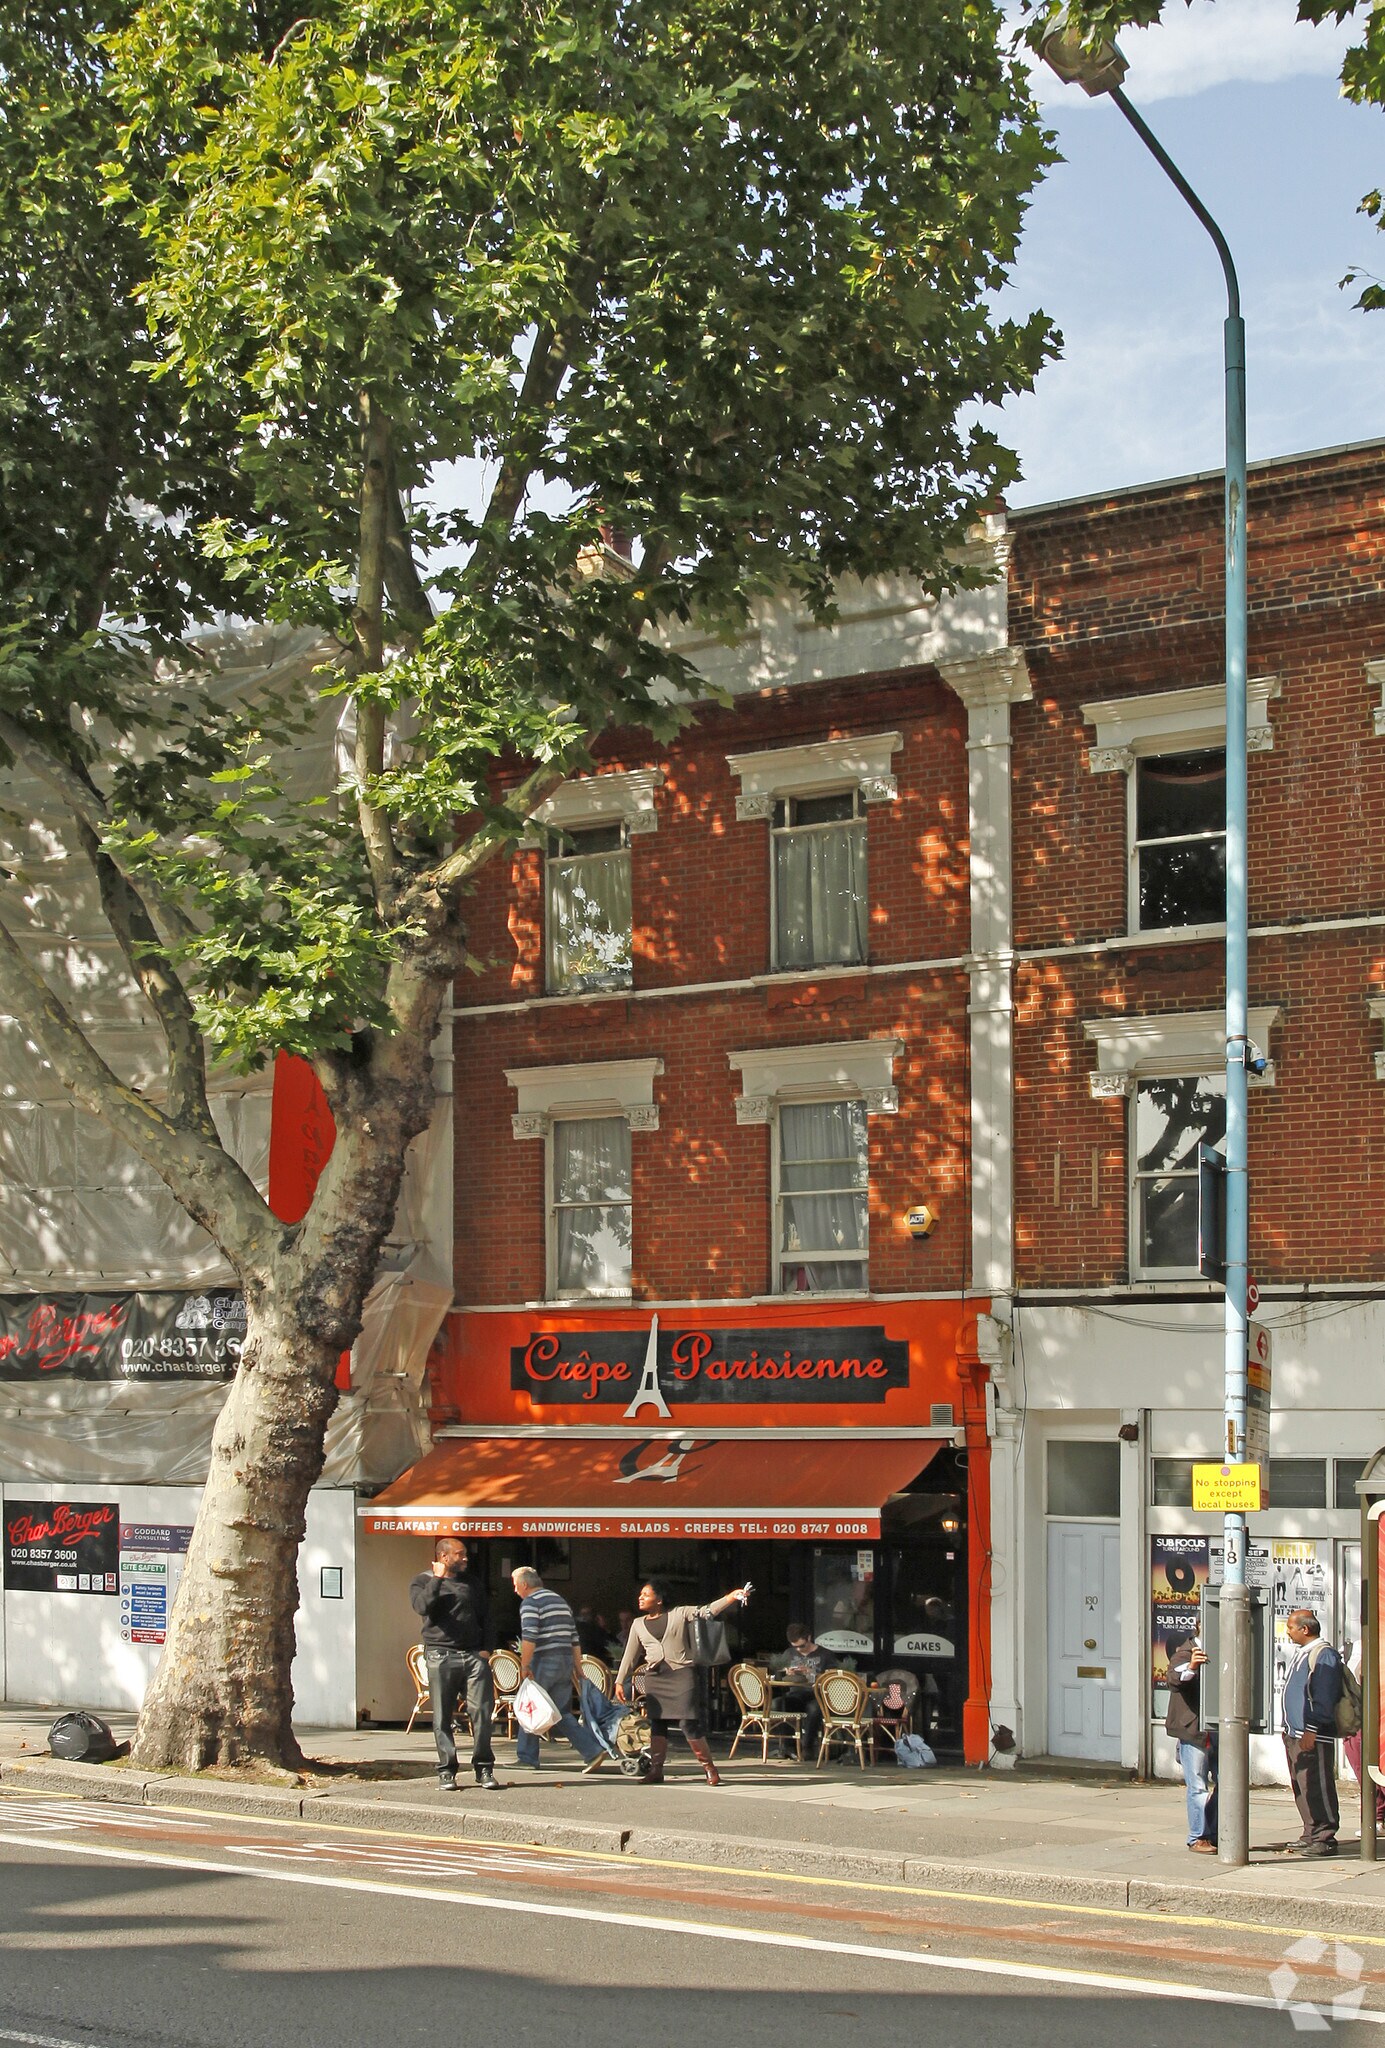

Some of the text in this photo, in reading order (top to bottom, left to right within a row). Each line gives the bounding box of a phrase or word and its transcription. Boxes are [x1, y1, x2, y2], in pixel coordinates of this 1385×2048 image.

[910, 1215, 924, 1223] ADT
[19, 1303, 127, 1370] Berger
[121, 1337, 243, 1358] 020 8357 36
[524, 1332, 889, 1400] Crêpe Parisienne
[1195, 1479, 1256, 1488] No stopping
[1209, 1490, 1242, 1498] except
[8, 1504, 115, 1546] Chas Berger
[373, 1521, 868, 1534] BREAKFAST COFFEES SANDWICHES SALADS CREPES TEL: 020 8747 0008
[134, 1528, 171, 1536] GODDARD
[1156, 1538, 1206, 1548] SUB FOCUS
[11, 1548, 77, 1560] 020 8357 3600
[1275, 1544, 1313, 1557] NELLY
[11, 1560, 77, 1568] www.chasberger.co.uk
[138, 1565, 165, 1573] SAFETY
[1085, 1595, 1098, 1605] 130
[1156, 1615, 1174, 1625] SUB
[907, 1641, 941, 1651] CAKES
